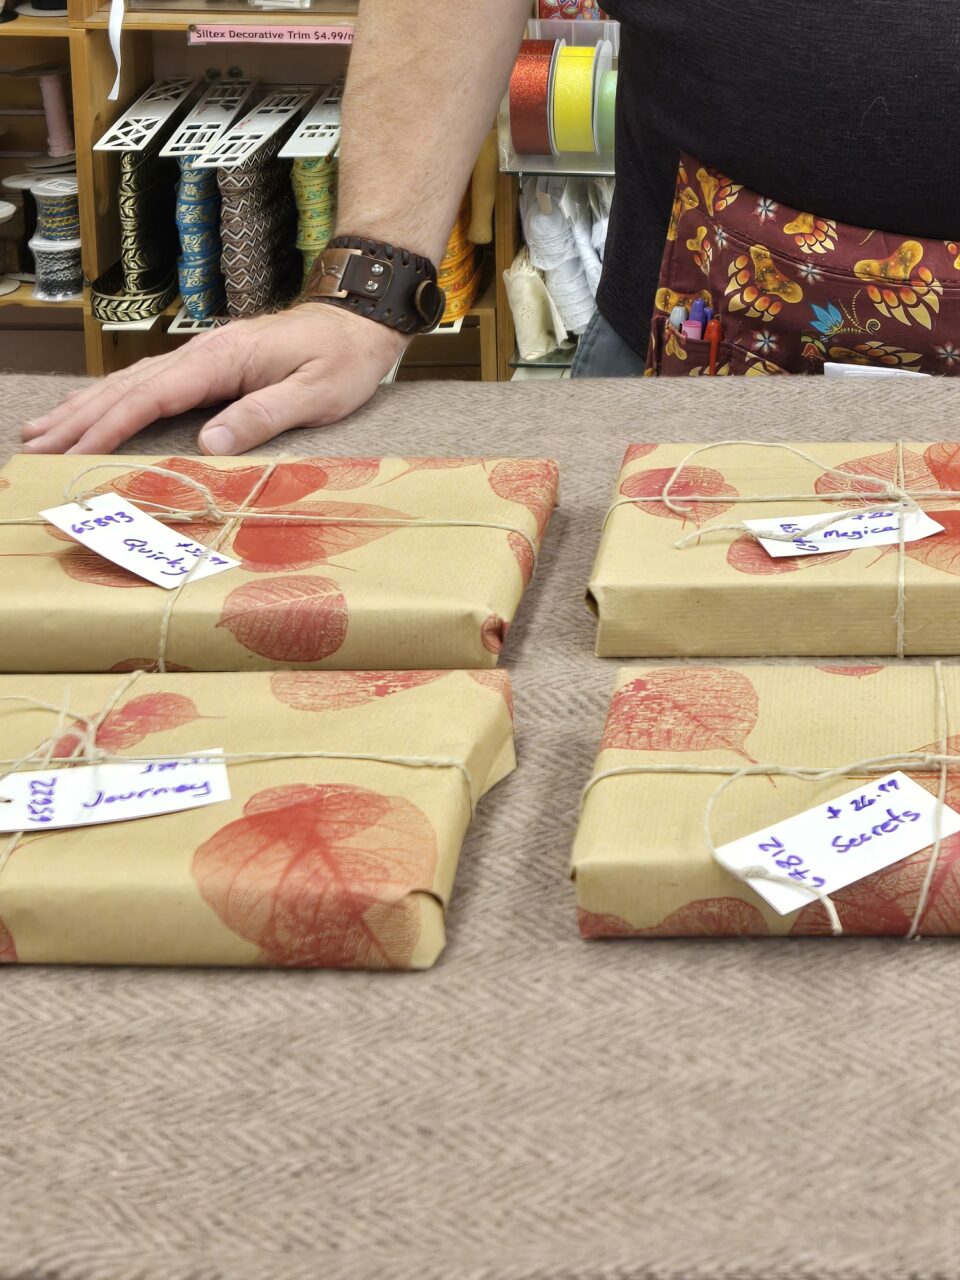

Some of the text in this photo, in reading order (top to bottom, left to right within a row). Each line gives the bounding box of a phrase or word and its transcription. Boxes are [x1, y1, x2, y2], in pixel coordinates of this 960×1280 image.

[196, 30, 226, 38] Siltex
[228, 31, 285, 40] Decorative
[287, 31, 311, 39] Trim
[823, 526, 901, 540] Magica
[122, 538, 189, 576] Quirky
[82, 780, 212, 808] Journey
[831, 808, 922, 854] Secrets
